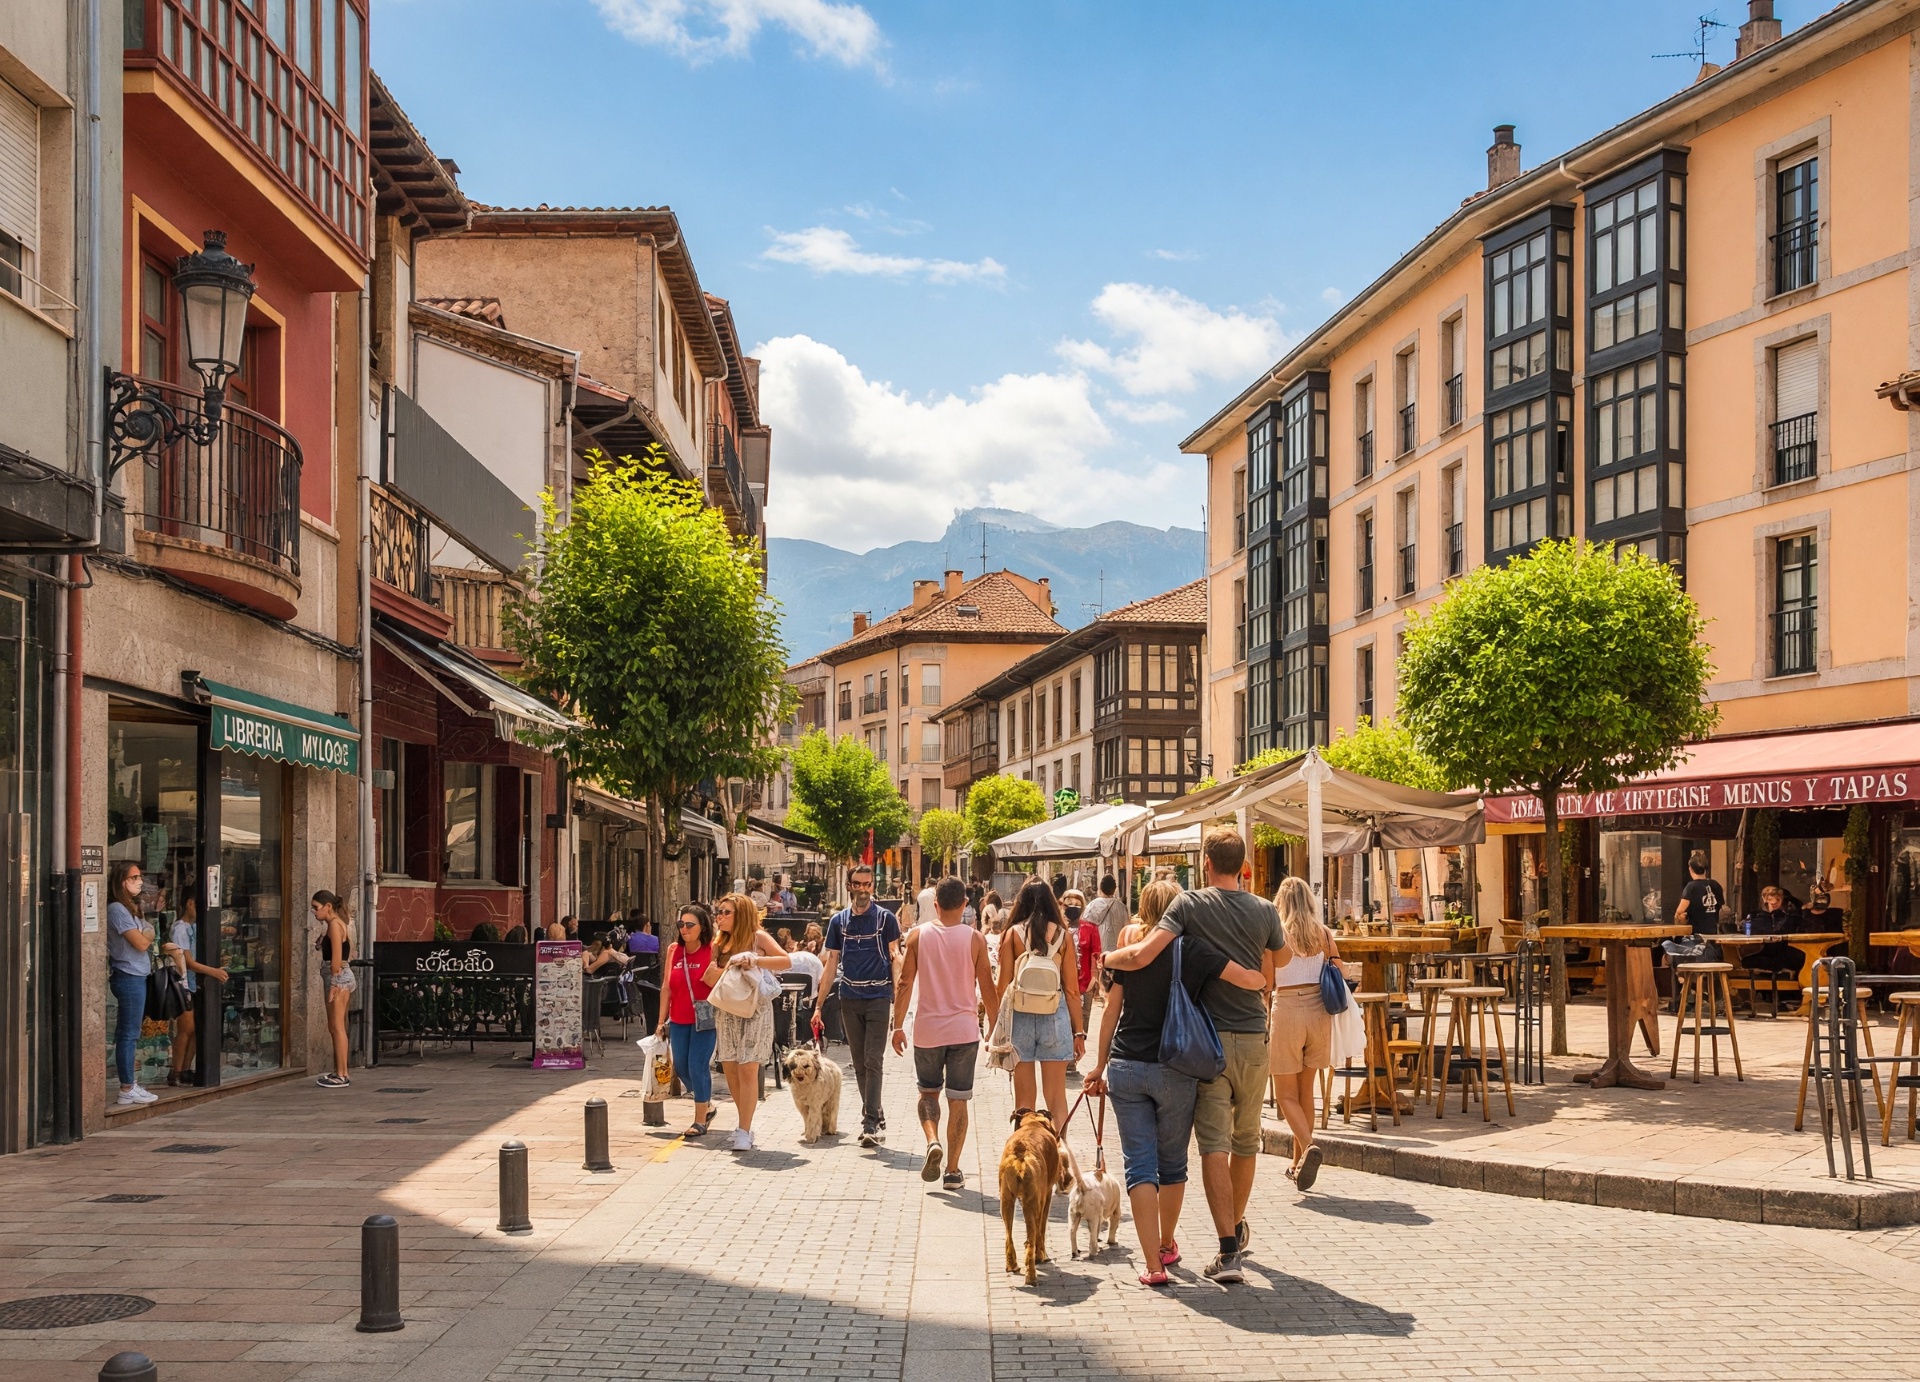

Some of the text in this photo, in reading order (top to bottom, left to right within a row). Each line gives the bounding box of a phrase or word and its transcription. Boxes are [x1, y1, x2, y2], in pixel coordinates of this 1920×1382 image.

[224, 714, 284, 754] LIBRERIA
[1723, 780, 1792, 805] MENUS
[1803, 778, 1818, 801] Y
[1830, 772, 1908, 800] TAPAS
